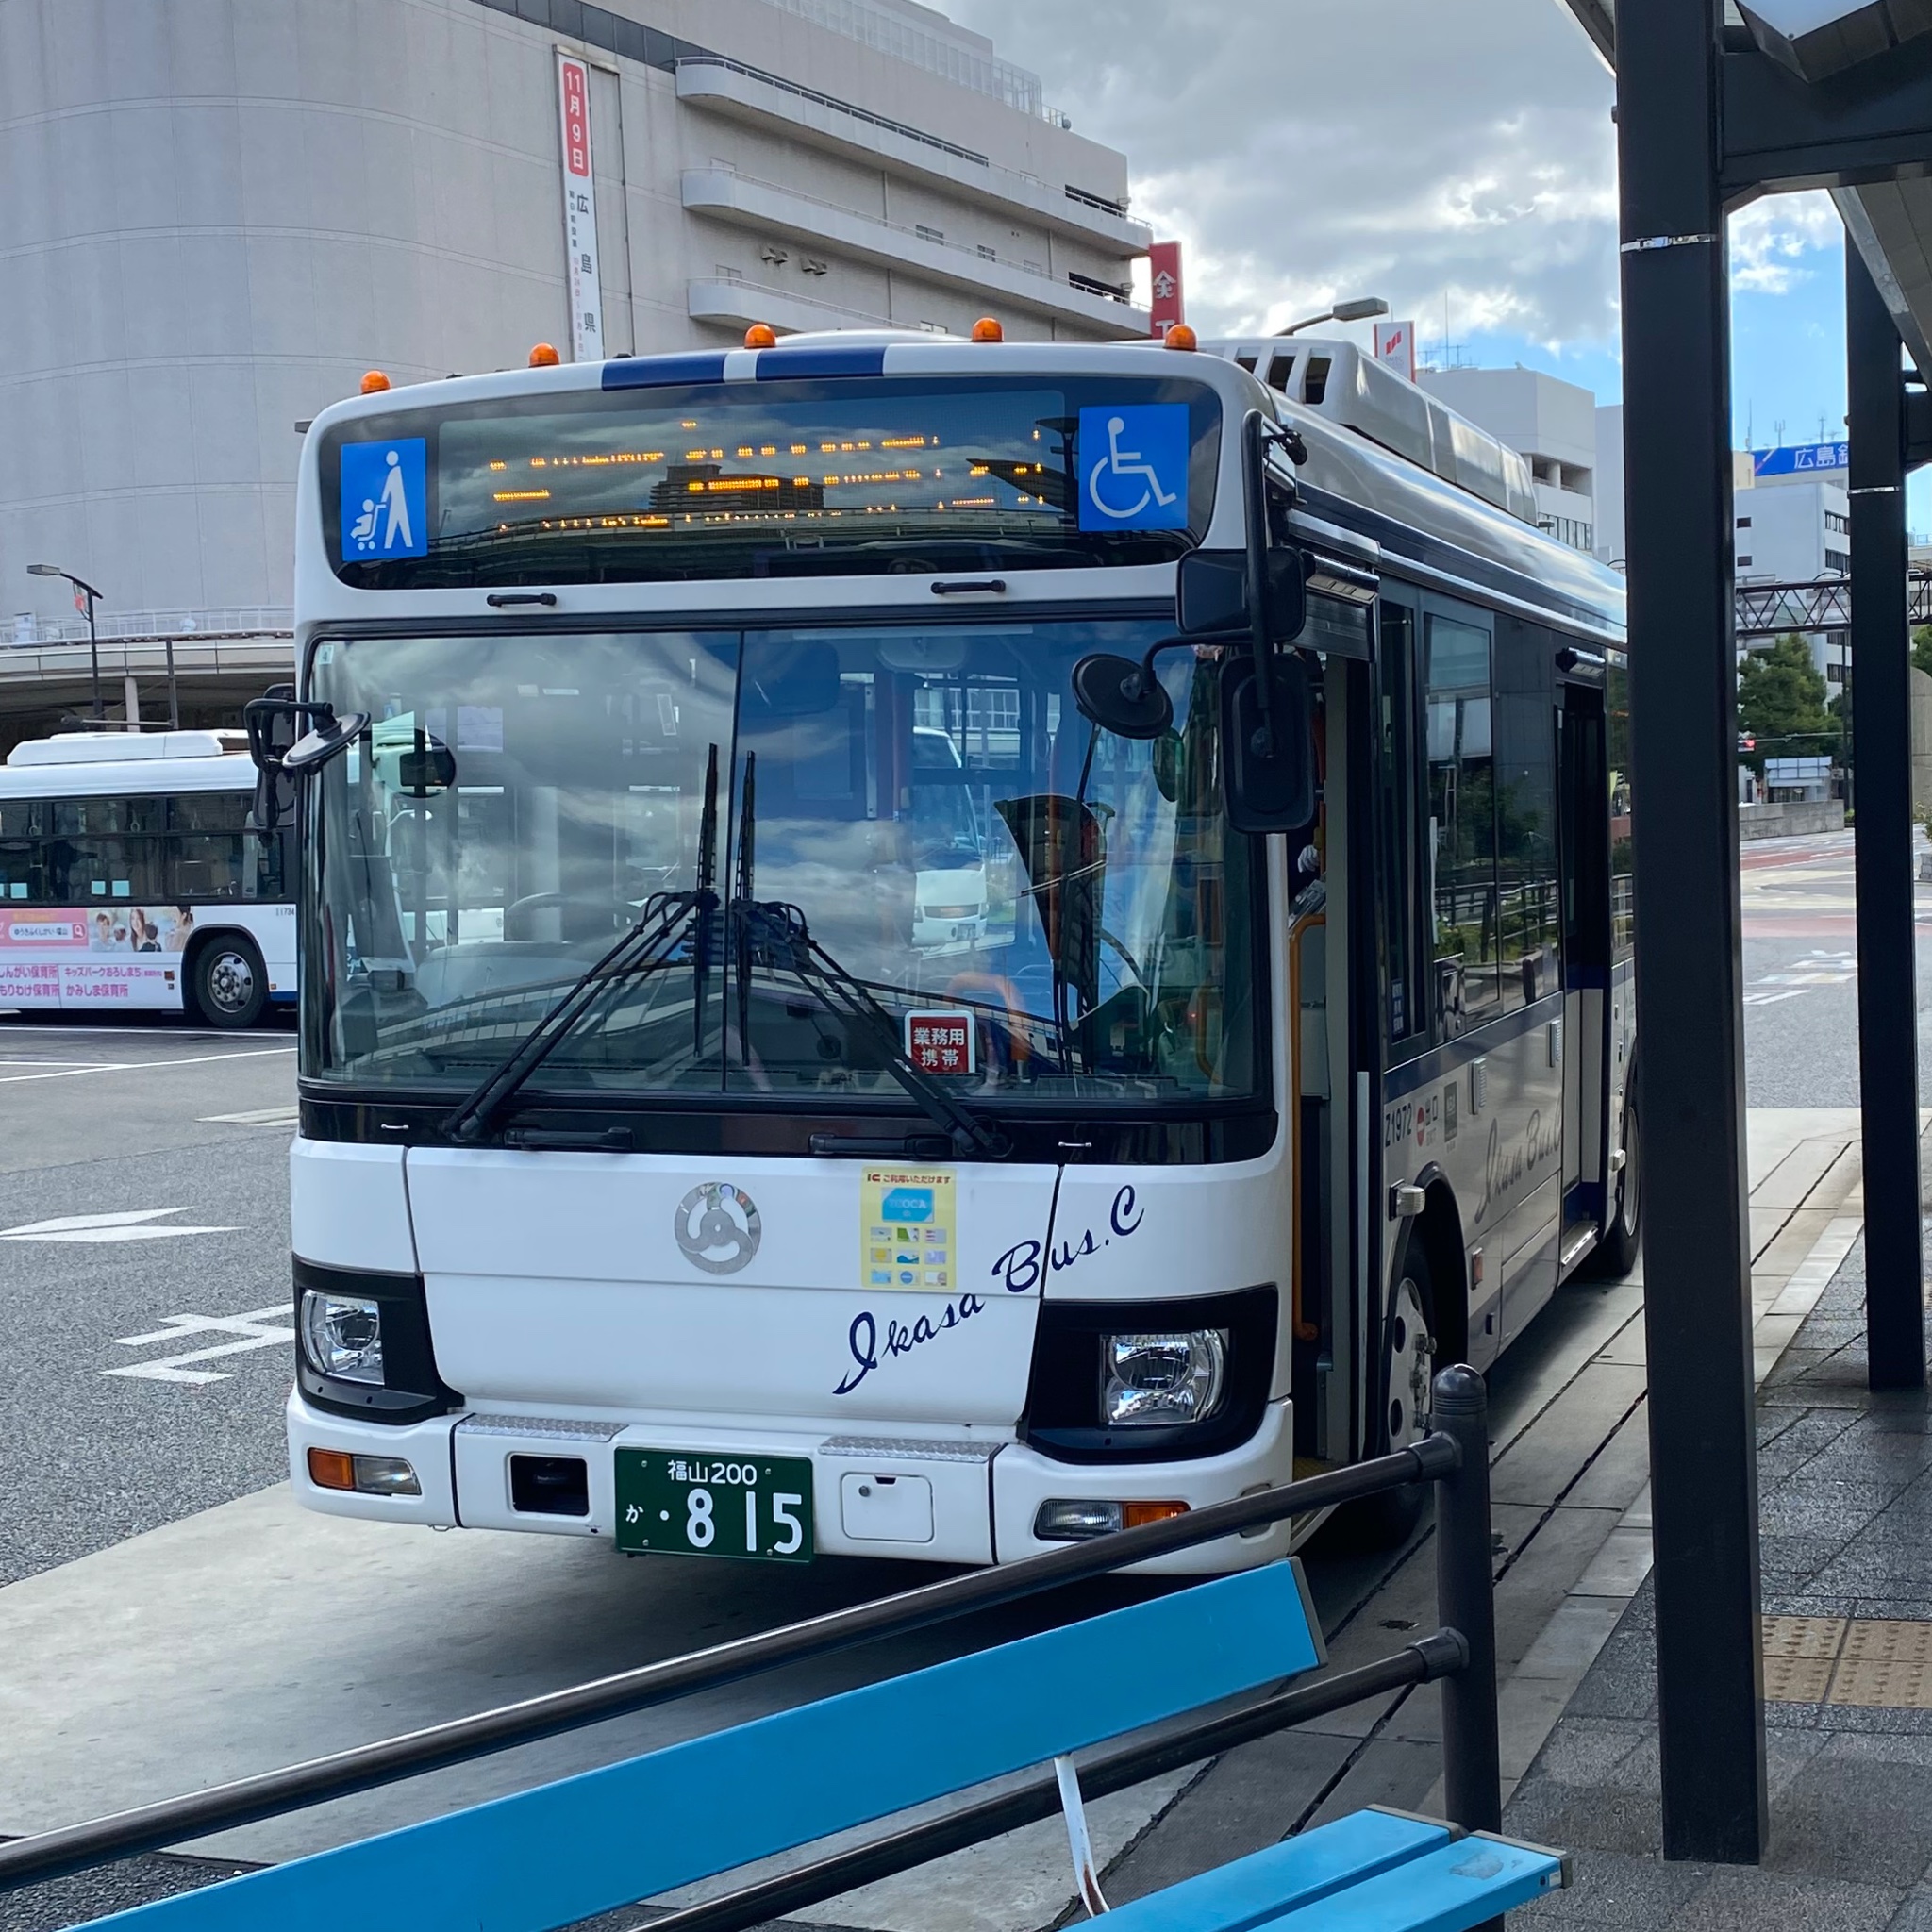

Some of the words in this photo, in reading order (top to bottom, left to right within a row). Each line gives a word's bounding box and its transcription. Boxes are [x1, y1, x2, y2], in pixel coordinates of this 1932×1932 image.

[566, 71, 584, 170] 11月9日
[66, 984, 128, 997] かみしま保育所
[913, 1026, 965, 1046] 業務用
[921, 1048, 959, 1067] 携帯
[1385, 1103, 1412, 1147] Z1972
[832, 1291, 986, 1395] Ikasa
[667, 1459, 757, 1485] 福山200
[625, 1504, 644, 1523] か
